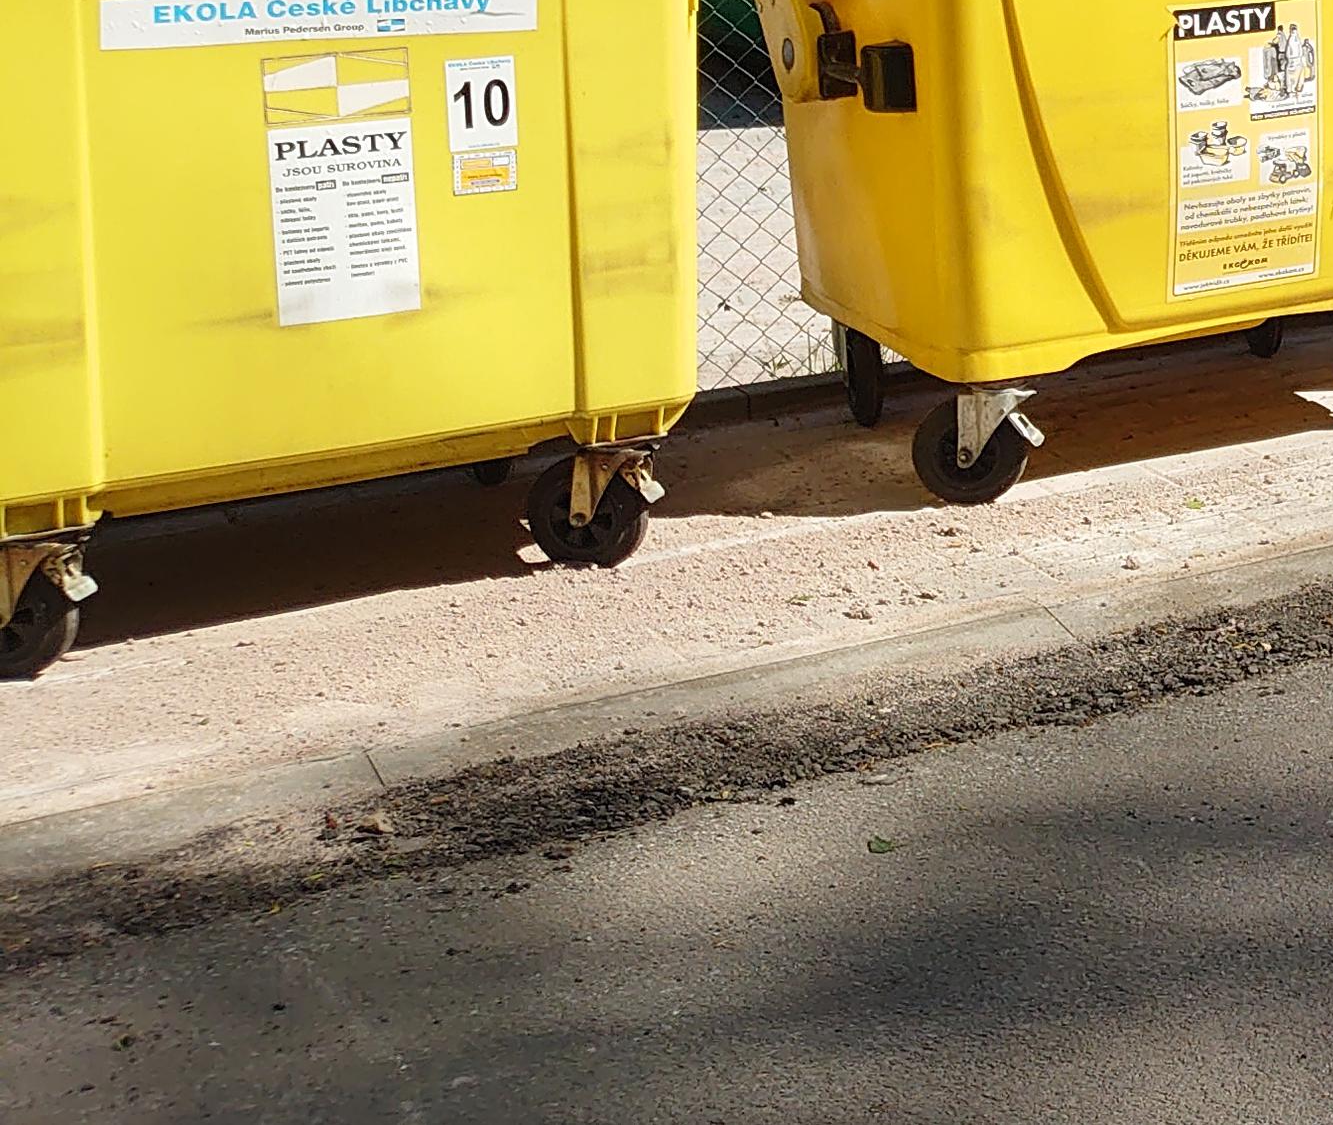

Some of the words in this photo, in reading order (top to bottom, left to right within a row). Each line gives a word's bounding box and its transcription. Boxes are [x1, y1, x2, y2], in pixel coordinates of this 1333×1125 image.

[153, 0, 256, 24] EKOLA
[1177, 6, 1272, 38] PLASTY
[244, 27, 280, 37] Marius
[282, 24, 331, 34] Pedersen
[333, 23, 365, 34] Group
[453, 78, 510, 129] 10
[273, 130, 408, 161] PLASTY
[282, 166, 323, 178] JSOU
[326, 158, 402, 174] SUROVINA
[1184, 212, 1195, 221] od
[1179, 245, 1231, 262] DĚKUJEME
[1233, 241, 1260, 253] VÁM,
[1262, 236, 1274, 249] ŽE
[1276, 233, 1313, 247] TŘÍDÍTE!
